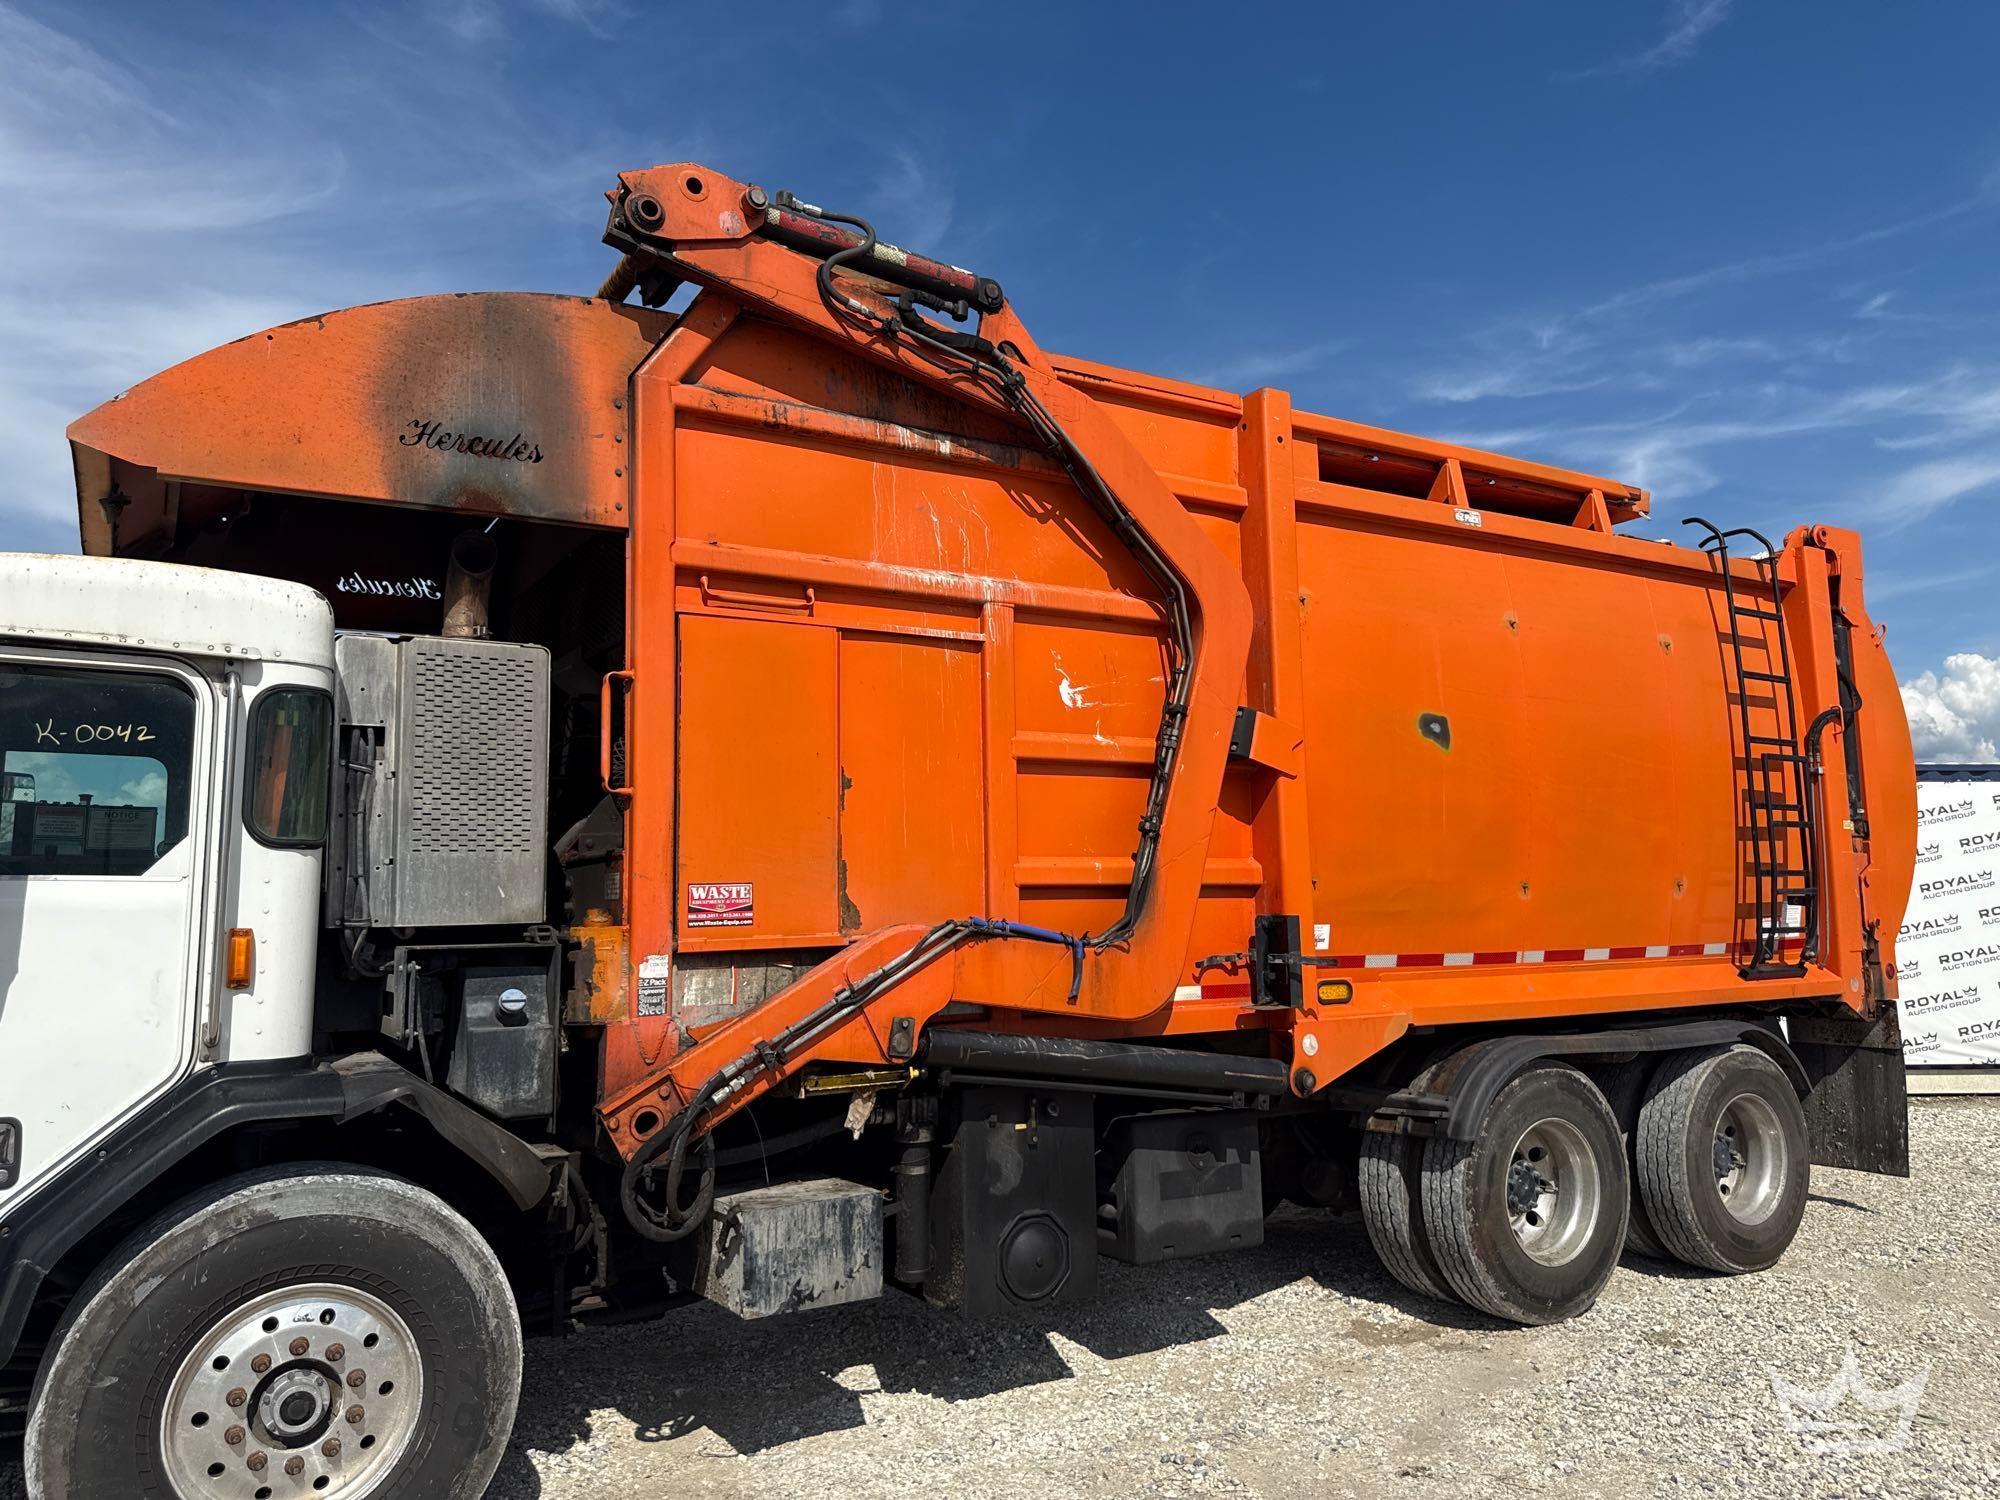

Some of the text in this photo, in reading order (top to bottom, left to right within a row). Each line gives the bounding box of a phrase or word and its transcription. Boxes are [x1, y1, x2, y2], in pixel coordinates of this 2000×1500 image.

[399, 420, 543, 463] Hercules
[36, 718, 156, 745] K-0042
[104, 811, 140, 819] NOTICE
[1918, 804, 1958, 819] OYAL
[1918, 811, 1976, 827] CTION GROUP
[1959, 832, 2000, 847] ROY
[1915, 855, 1942, 864] ROUP
[1920, 874, 1978, 893] ROYAL
[1923, 881, 1995, 900] AUCTION GROUP
[691, 886, 750, 899] WASTE
[1895, 925, 1962, 943] UCTION GROUP
[1900, 919, 1944, 935] OYAL
[1939, 945, 1997, 964] ROYAL
[1942, 954, 2000, 972] AUCTION GRO
[650, 978, 666, 986] Pack
[1898, 971, 1922, 980] ROUP
[639, 994, 665, 1003] Smart
[1905, 991, 1963, 1010] ROYAL
[1908, 997, 1981, 1016] AUCTION GROUP
[639, 1002, 665, 1016] Steel
[1958, 1020, 2000, 1037] ROY
[1909, 1044, 1941, 1055] GROUP
